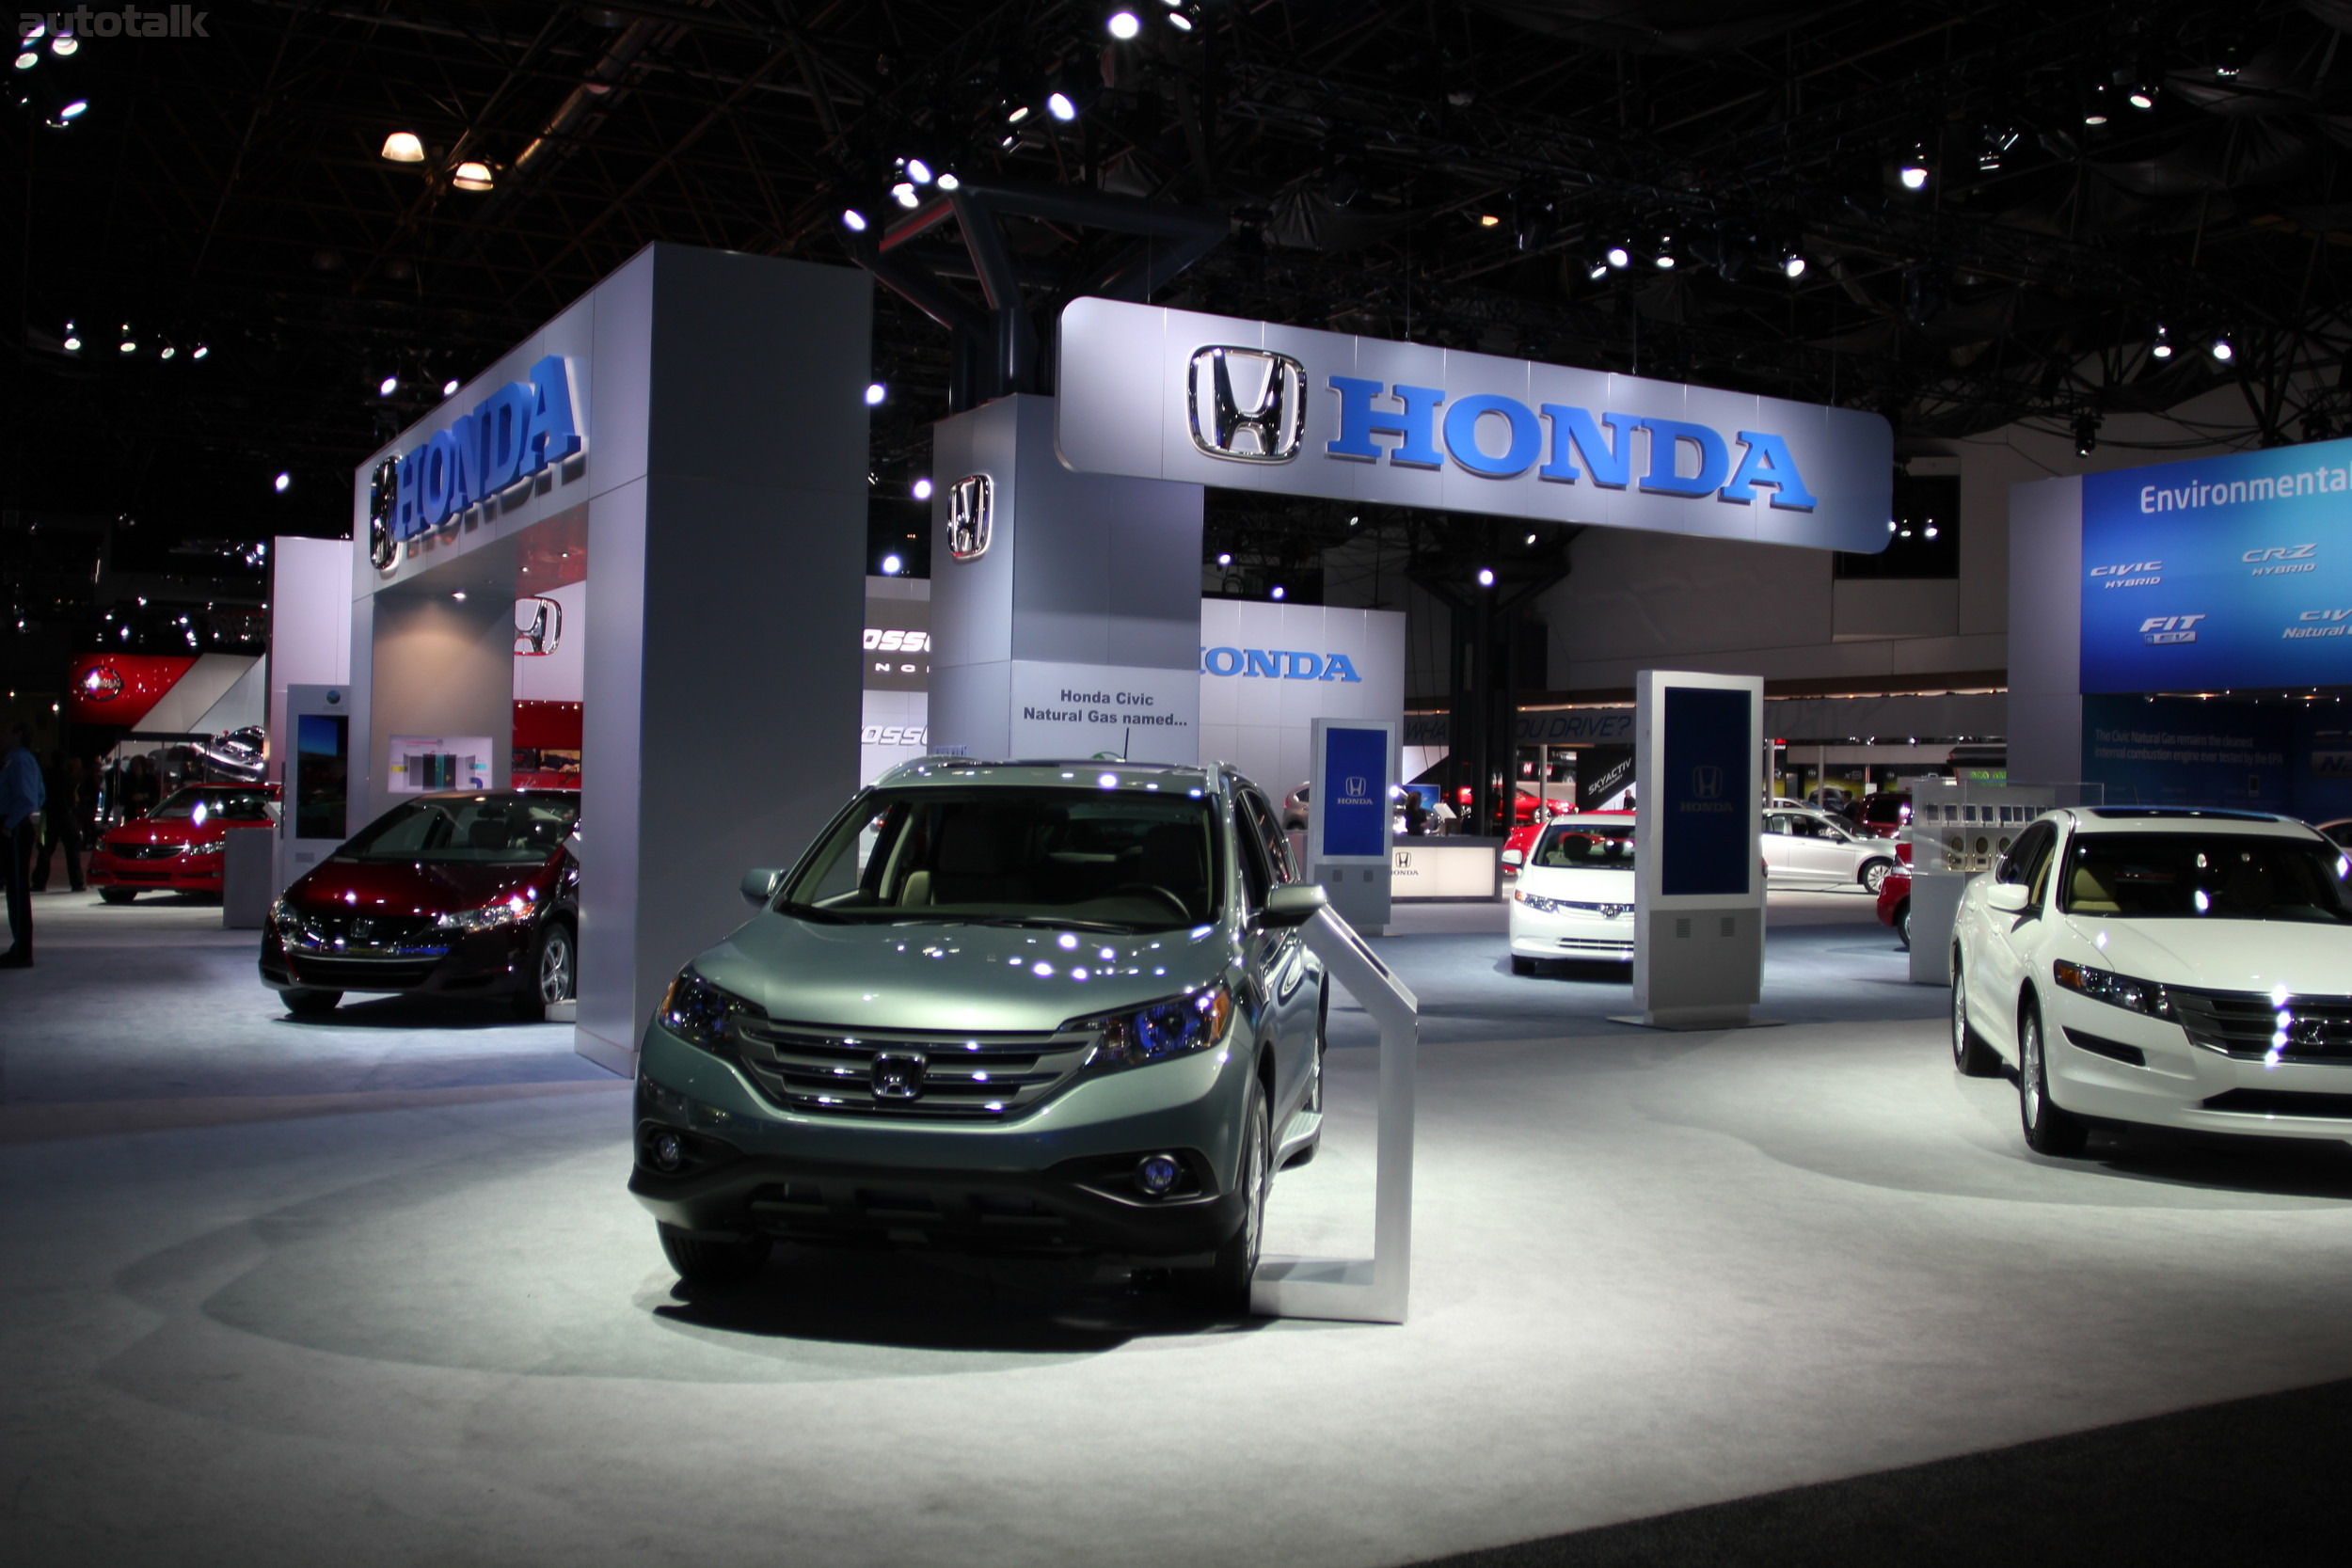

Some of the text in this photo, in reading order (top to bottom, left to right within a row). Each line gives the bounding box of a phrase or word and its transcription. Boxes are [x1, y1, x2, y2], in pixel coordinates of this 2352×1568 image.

[393, 355, 581, 543] HONDA
[1327, 375, 1817, 511] HONDA
[2090, 561, 2162, 577] CIVIC
[2251, 563, 2316, 576] HYBRID
[2105, 577, 2161, 589] HYBRID
[2138, 614, 2206, 632] FIT
[2281, 625, 2346, 639] Natural
[1060, 689, 1154, 705] Honda Civic
[1024, 706, 1187, 726] Natural Gas named...
[1513, 718, 1547, 738] OU
[1549, 716, 1632, 738] DRIVE?
[2131, 730, 2161, 744] Natural
[2162, 732, 2176, 745] Gas
[1588, 756, 1631, 796] SKYACTIV
[1337, 797, 1374, 805] HONDA
[1679, 801, 1734, 813] HONDA
